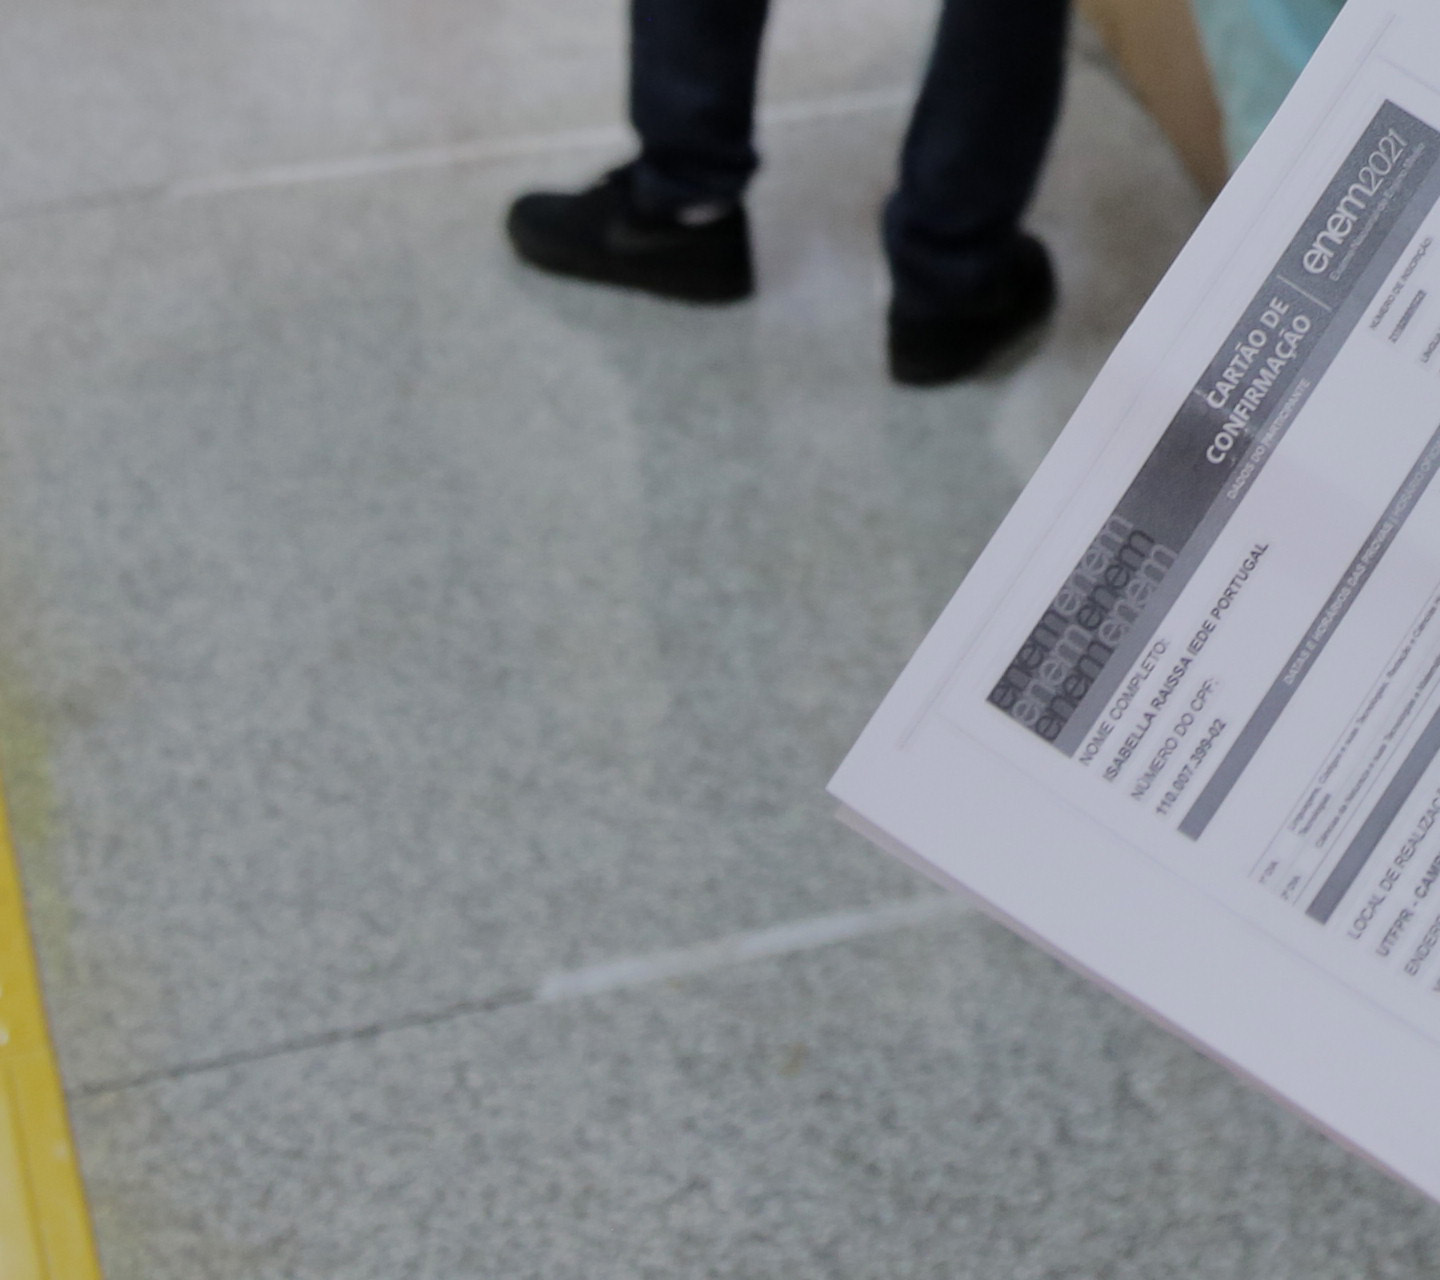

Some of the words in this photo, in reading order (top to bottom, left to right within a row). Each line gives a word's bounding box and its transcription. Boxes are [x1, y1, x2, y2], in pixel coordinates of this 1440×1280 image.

[1199, 308, 1318, 470] CONFIRMAÇÃO
[1201, 323, 1270, 412] CARTÃO
[1258, 295, 1290, 330] DE
[1224, 460, 1256, 500] DADOS
[1249, 444, 1267, 464] DO
[1258, 375, 1311, 448] PARTICIPANTE
[1078, 719, 1116, 768] NOME
[1108, 635, 1171, 723] COMPLETO:
[1101, 708, 1157, 784] ISABELLA
[1149, 653, 1194, 712] RAISSA
[1185, 617, 1217, 657] IEDE
[1209, 538, 1269, 621] PORTUGAL
[1128, 734, 1180, 803] NÚMERO
[1172, 710, 1196, 738] DO
[1188, 675, 1220, 714] CPF:
[1154, 715, 1228, 819] 110.007.399-02
[1346, 889, 1386, 941] LOCAL
[1378, 866, 1401, 892] DE
[1374, 906, 1415, 958] UTFPR
